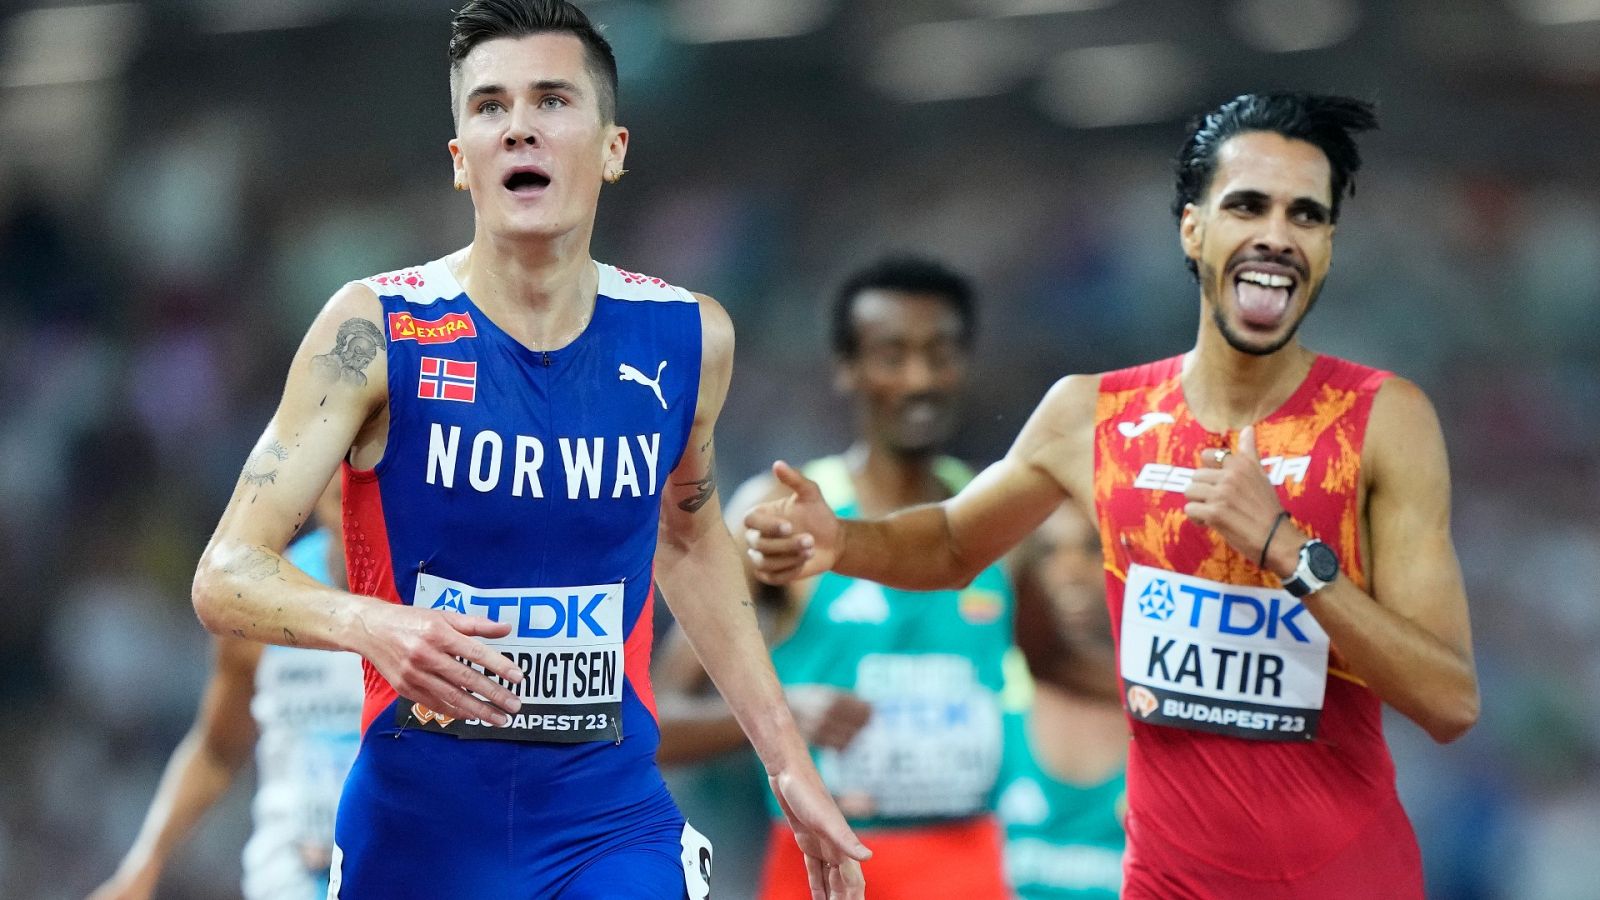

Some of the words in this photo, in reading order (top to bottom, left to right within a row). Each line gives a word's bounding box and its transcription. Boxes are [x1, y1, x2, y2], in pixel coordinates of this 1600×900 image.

[416, 320, 469, 337] EXTRA
[425, 422, 661, 500] NORWAY
[470, 593, 608, 638] TDK
[1180, 584, 1311, 643] TDK
[1147, 636, 1285, 698] KATIR
[585, 715, 607, 730] 23
[1162, 699, 1279, 731] BUDAPEST
[1279, 716, 1306, 732] 23
